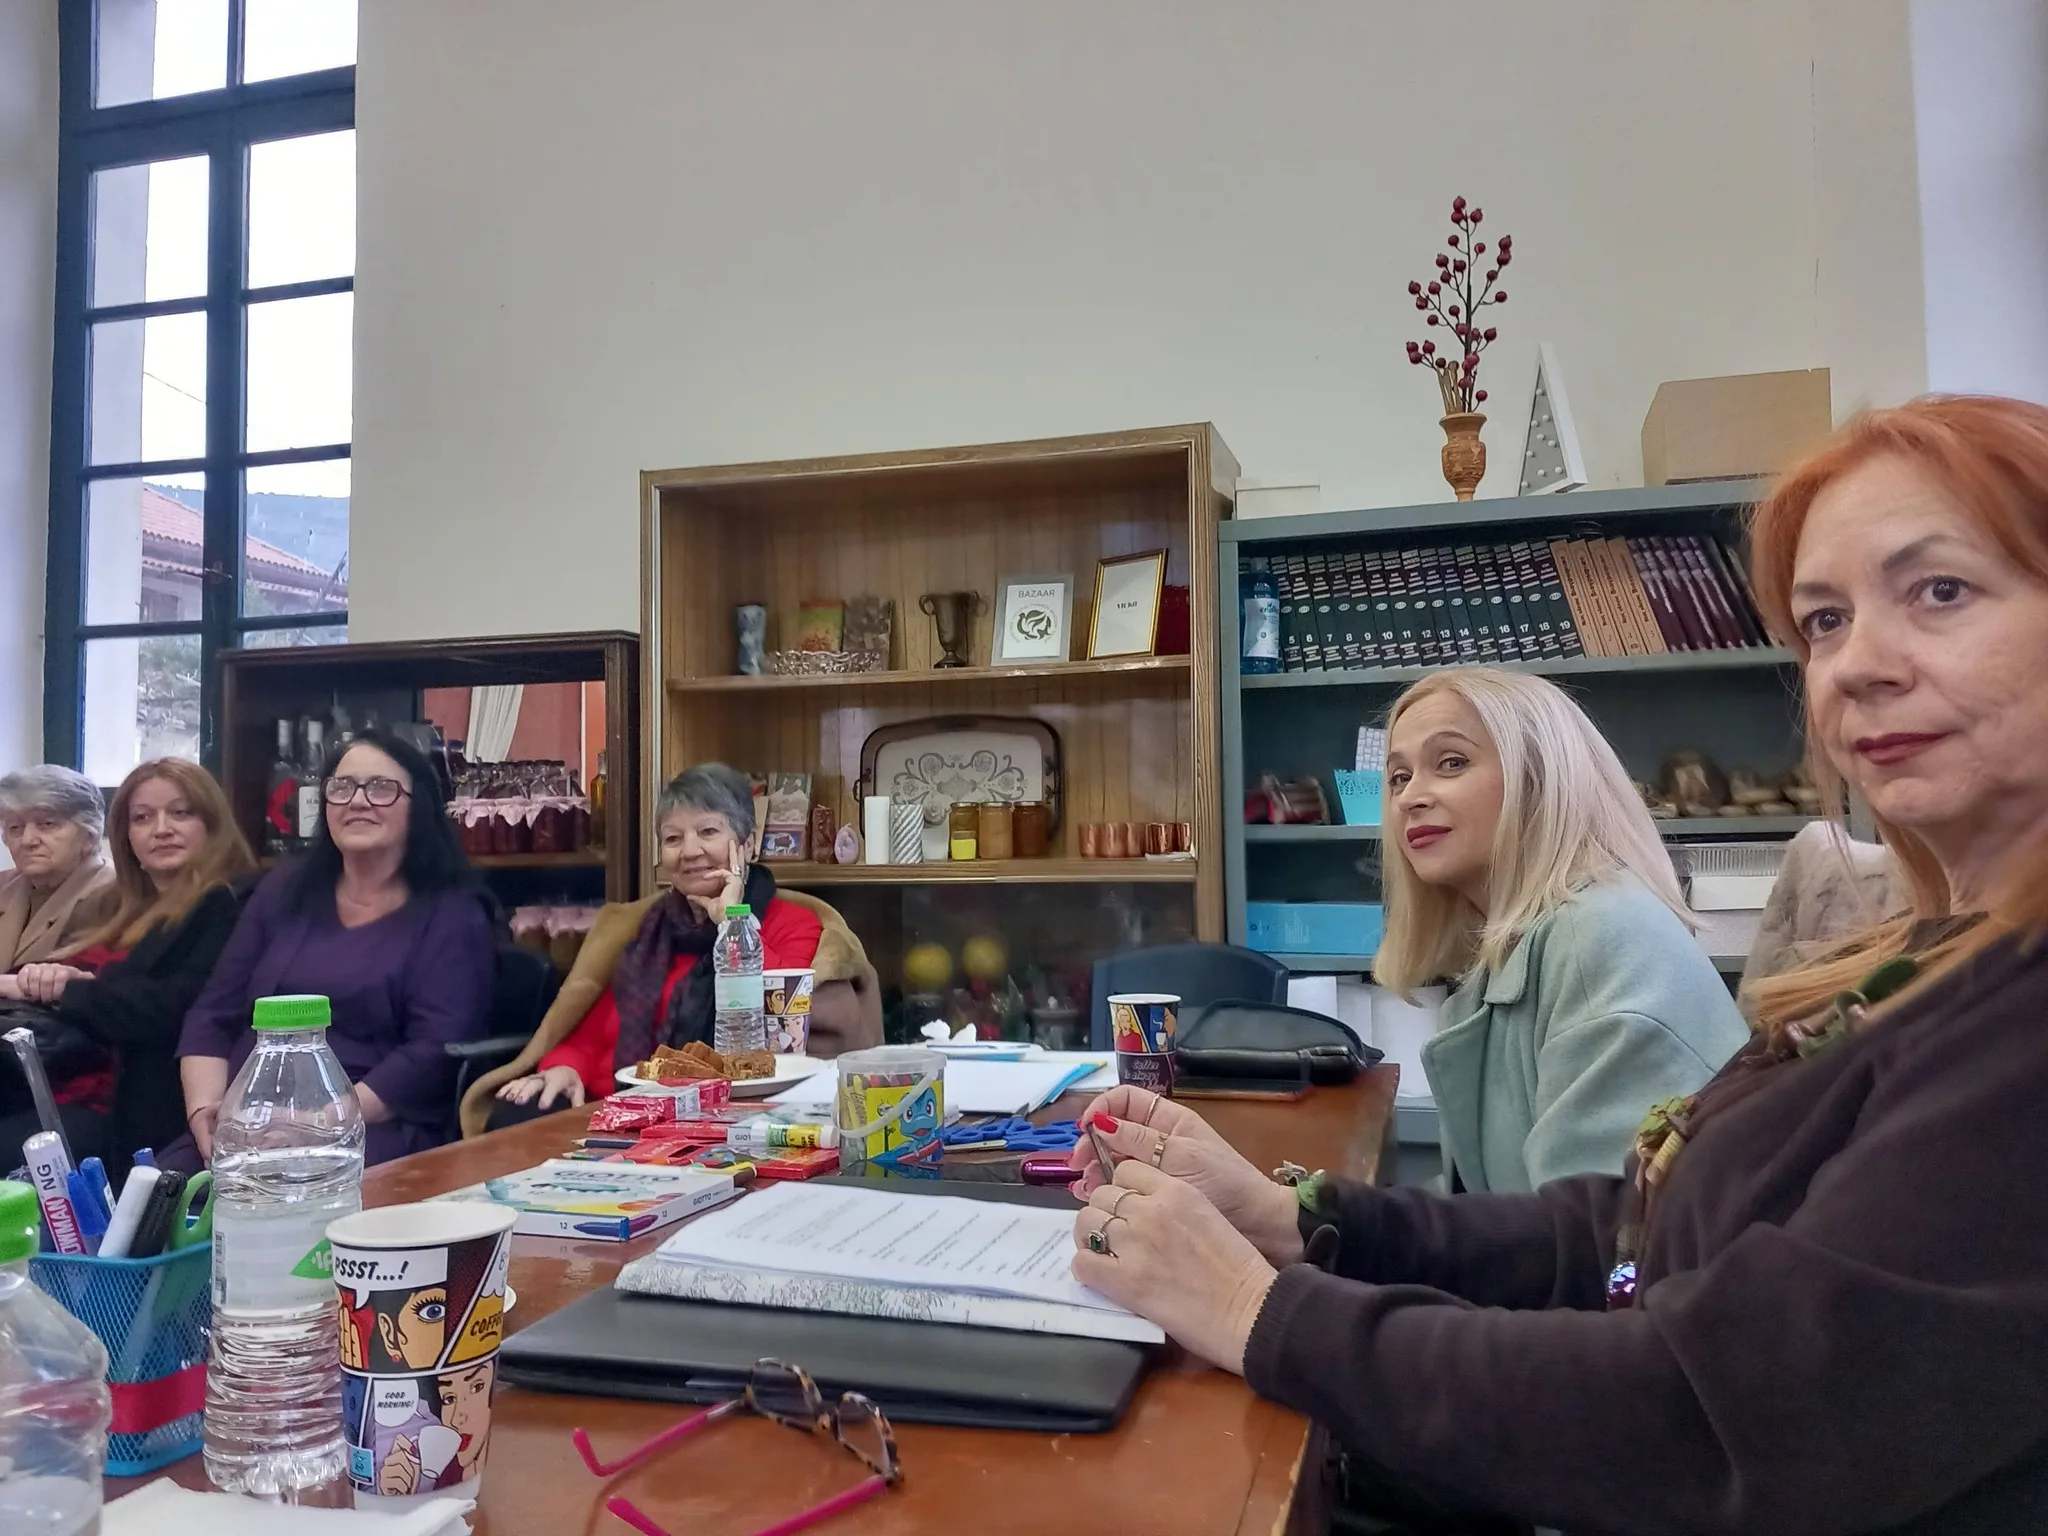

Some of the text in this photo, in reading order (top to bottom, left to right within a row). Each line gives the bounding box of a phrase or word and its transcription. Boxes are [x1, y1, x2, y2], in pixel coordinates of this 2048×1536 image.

[1018, 589, 1056, 598] BAZAAR
[1477, 625, 1489, 635] 15
[1498, 624, 1511, 634] 16
[1519, 623, 1530, 633] 17
[1538, 621, 1550, 632] 18
[1559, 620, 1571, 631] 19
[1363, 631, 1372, 641] 9
[1381, 630, 1394, 641] 10
[1402, 630, 1412, 639] 11
[1421, 629, 1432, 638] 12
[1439, 629, 1451, 639] 13
[1458, 627, 1470, 637] 14
[1288, 635, 1296, 644] 5
[1306, 634, 1313, 643] 6
[1326, 634, 1334, 642] 7
[1345, 633, 1353, 642] 8
[37, 1164, 56, 1190] NG
[553, 1170, 680, 1182] GIOTTO
[692, 1192, 712, 1206] GIOTTO
[661, 1210, 668, 1218] 12
[559, 1221, 568, 1230] 12
[385, 1391, 406, 1399] GOOD
[377, 1400, 415, 1409] MORNING!
